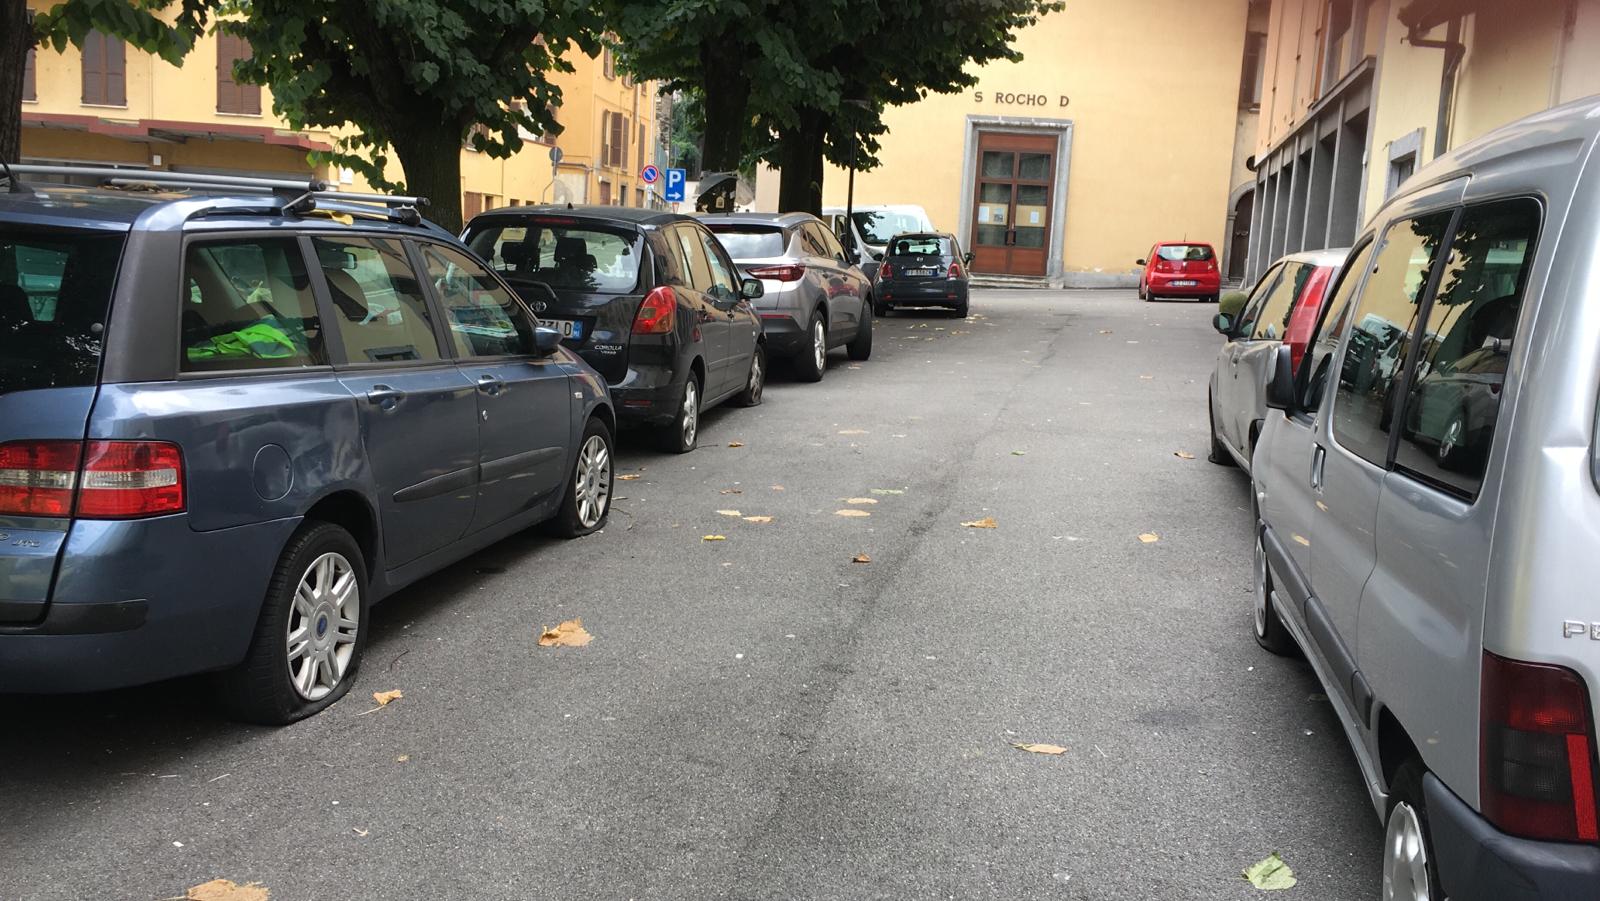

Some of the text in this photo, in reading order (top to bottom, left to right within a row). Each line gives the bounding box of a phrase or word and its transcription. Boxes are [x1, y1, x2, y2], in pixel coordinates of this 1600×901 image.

[974, 91, 1070, 107] S ROCHO D
[668, 170, 682, 188] P
